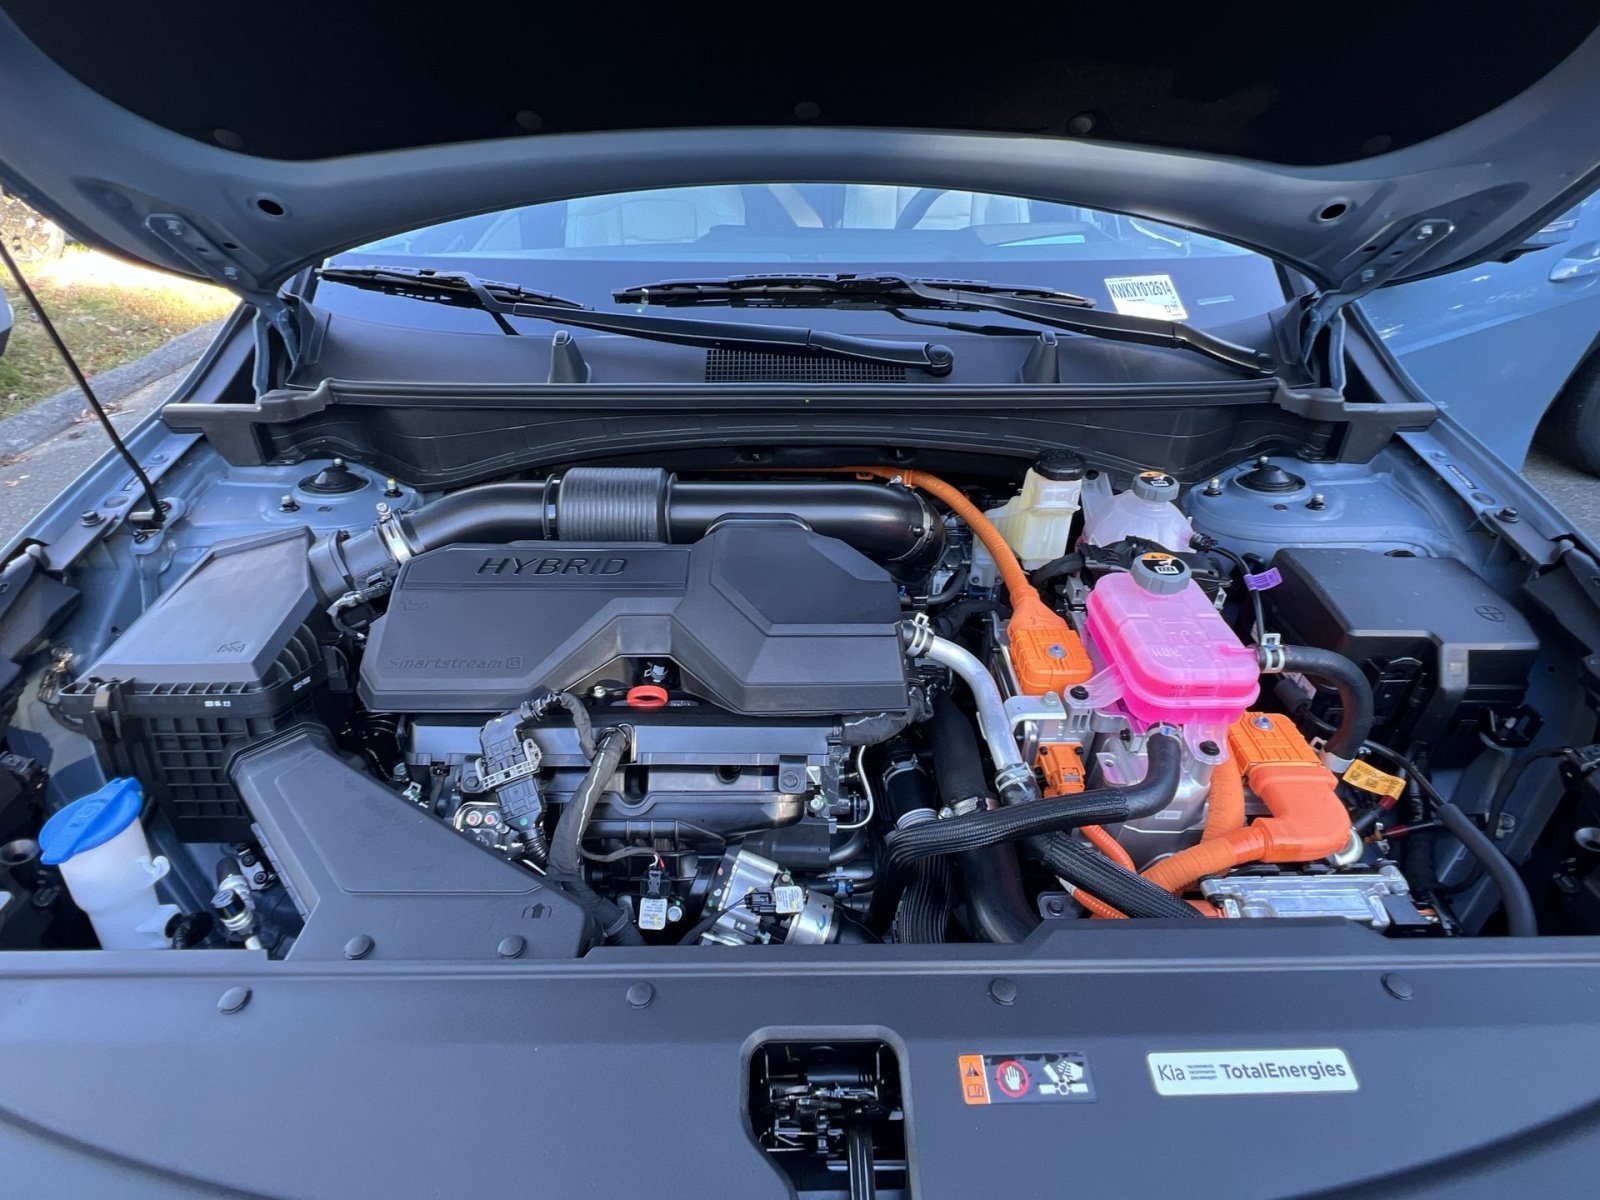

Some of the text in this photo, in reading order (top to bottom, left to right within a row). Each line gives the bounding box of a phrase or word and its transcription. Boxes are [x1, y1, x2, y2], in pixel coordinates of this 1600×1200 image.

[476, 557, 628, 576] HYBRID
[388, 657, 502, 670] Smartstream
[1157, 1060, 1347, 1082] Kia TotalEnergies
